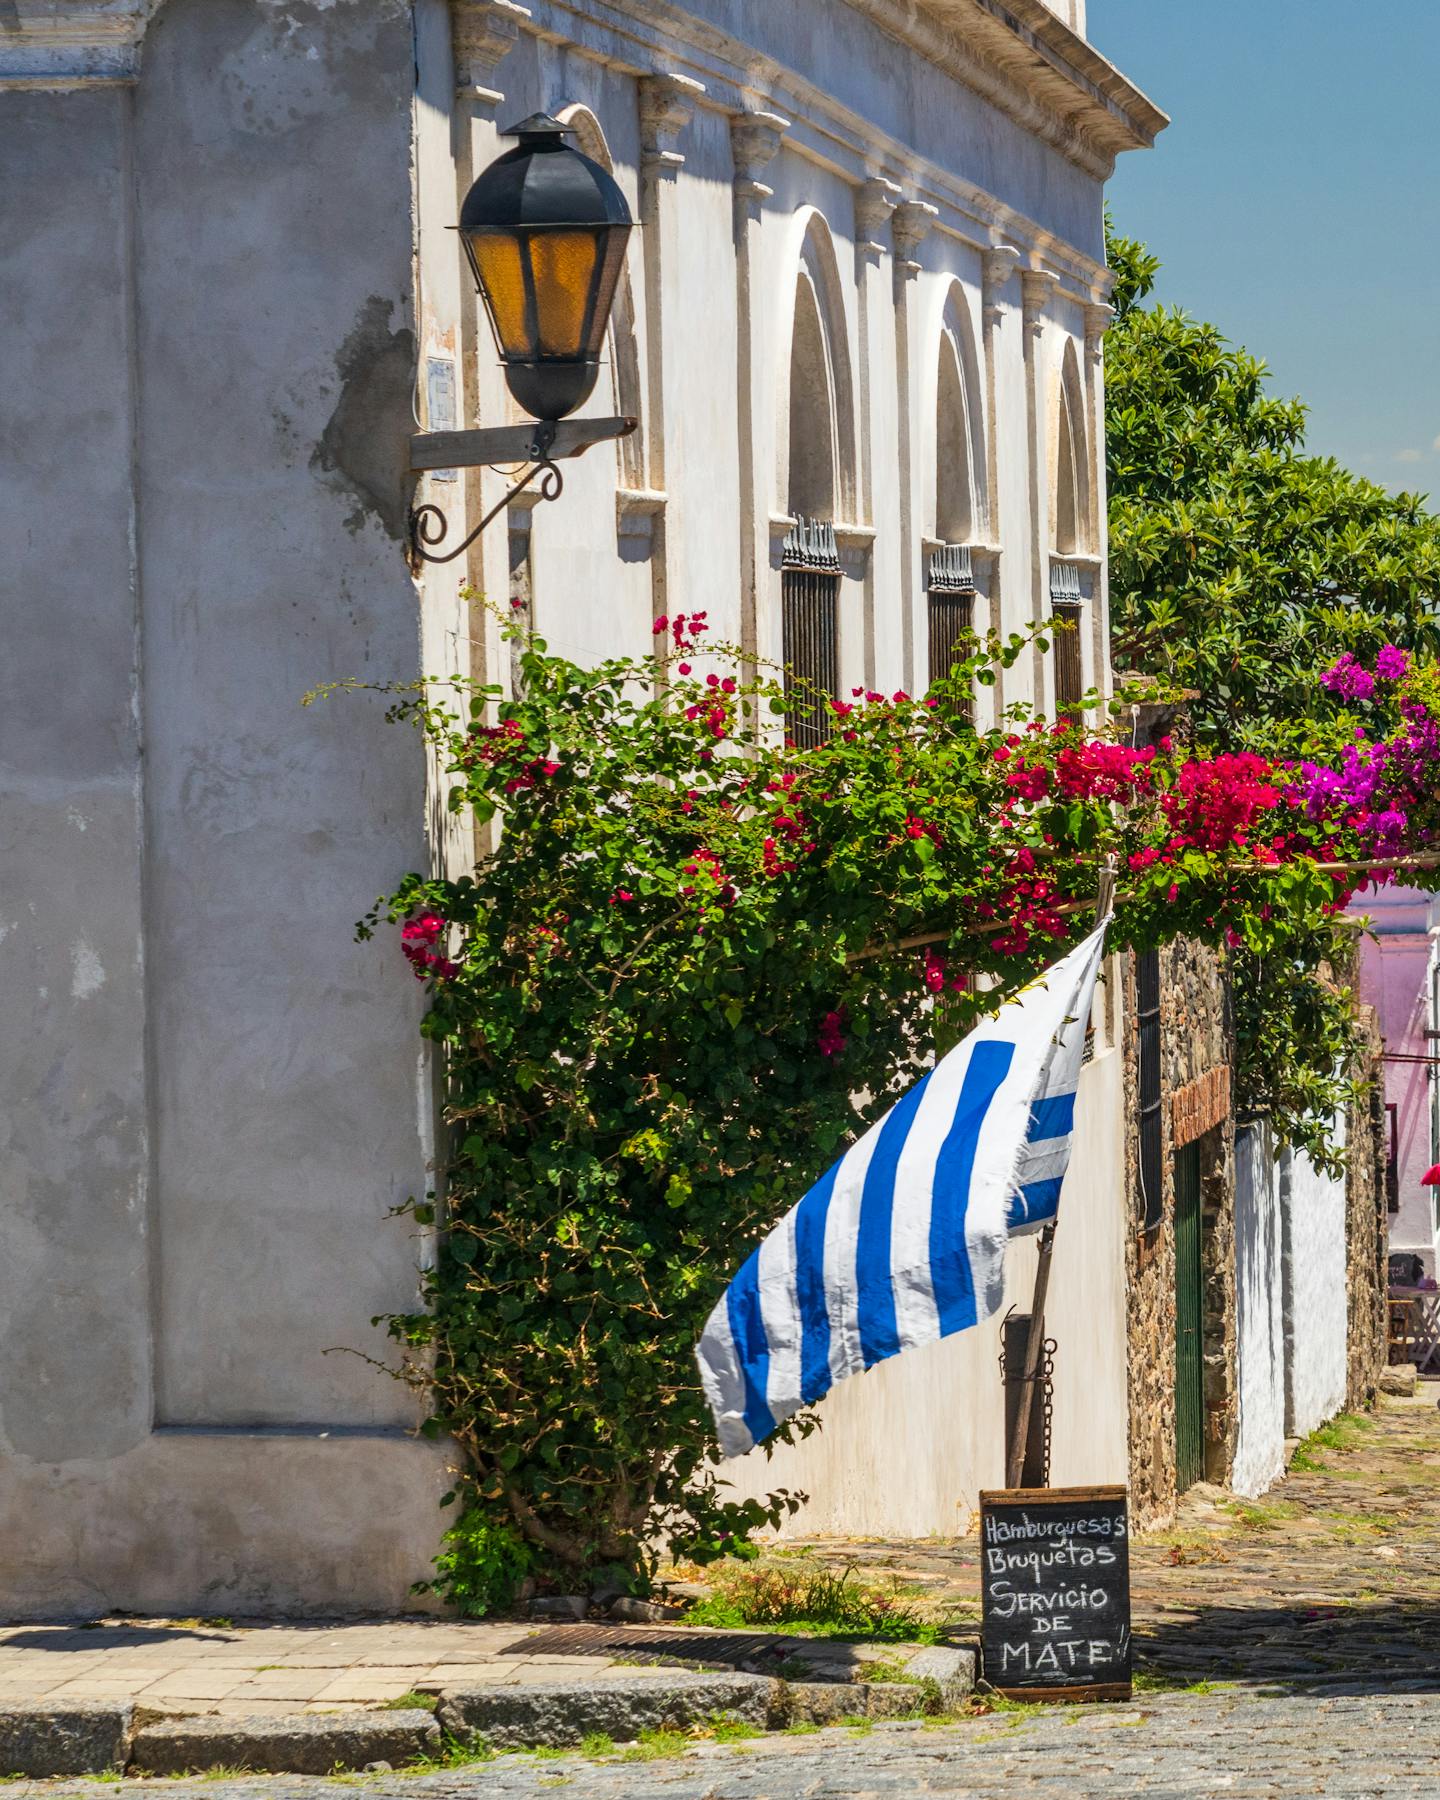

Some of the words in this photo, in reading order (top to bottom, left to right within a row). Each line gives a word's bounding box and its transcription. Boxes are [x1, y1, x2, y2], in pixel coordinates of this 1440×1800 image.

[986, 1512, 1126, 1547] Hamburguesas
[987, 1540, 1117, 1584] Bruquetas
[1032, 1615, 1073, 1633] DE
